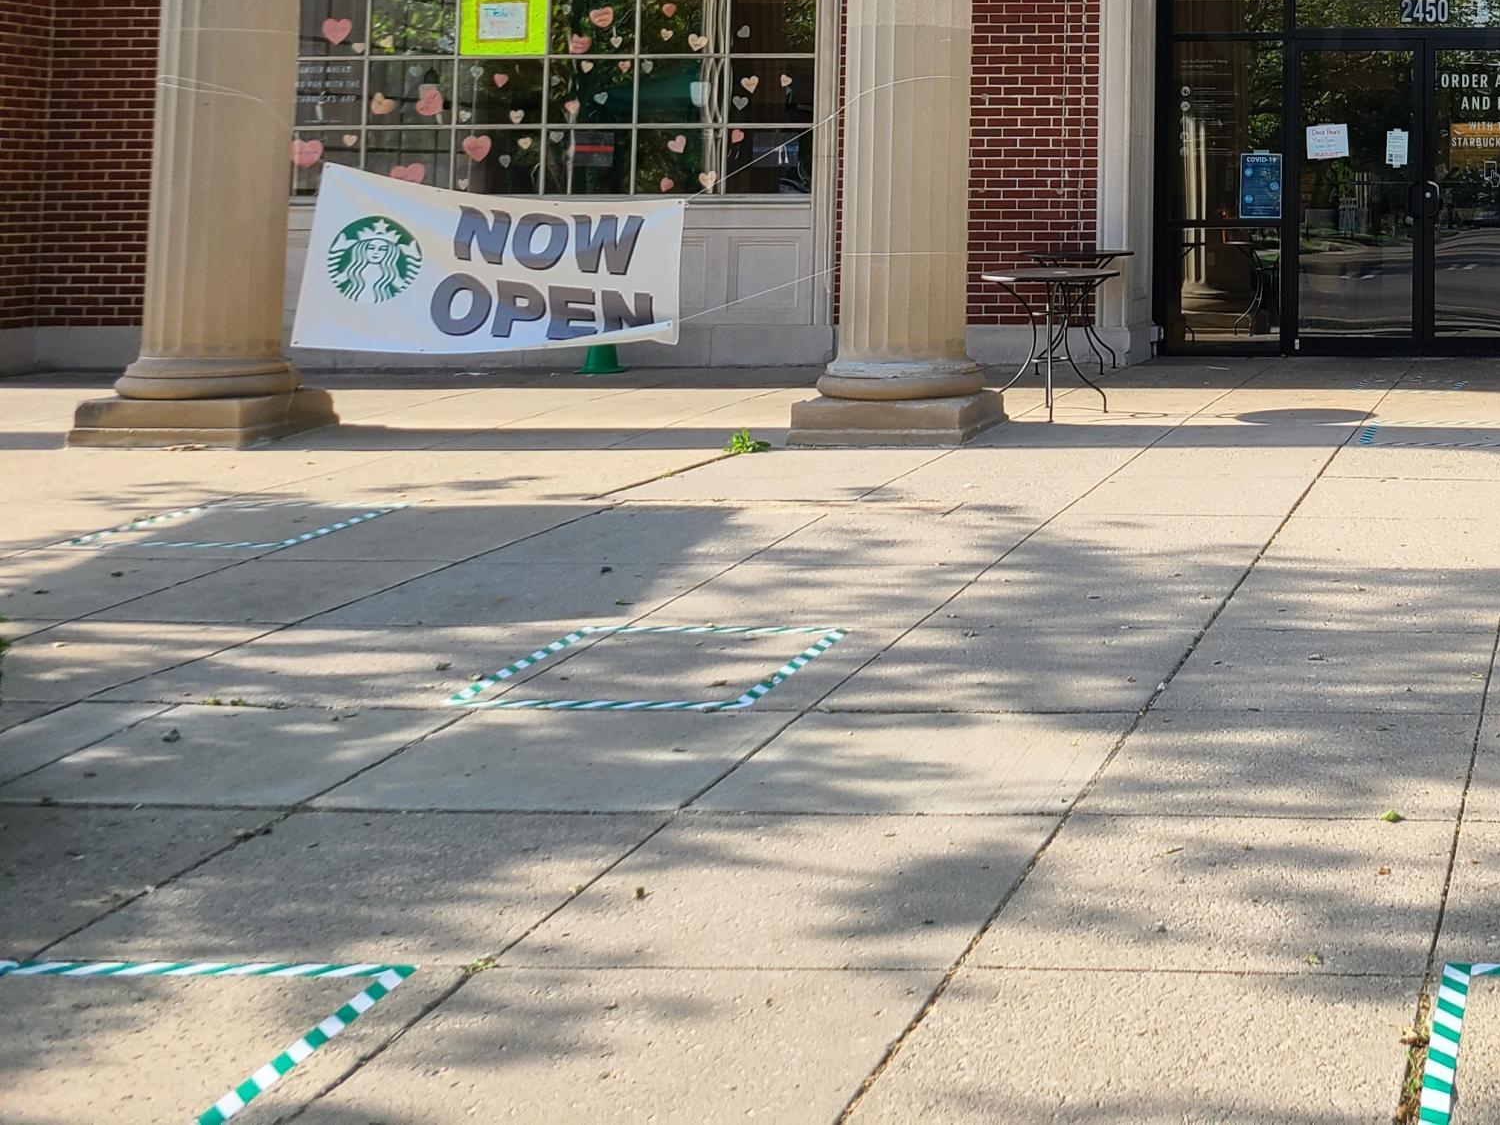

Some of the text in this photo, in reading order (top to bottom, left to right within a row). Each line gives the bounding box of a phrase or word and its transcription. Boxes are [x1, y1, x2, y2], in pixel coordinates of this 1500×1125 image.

[1440, 73, 1488, 88] ORDER
[1460, 96, 1491, 111] AND
[1468, 121, 1493, 132] WITH
[455, 205, 645, 275] NOW
[430, 272, 655, 341] OPEN
